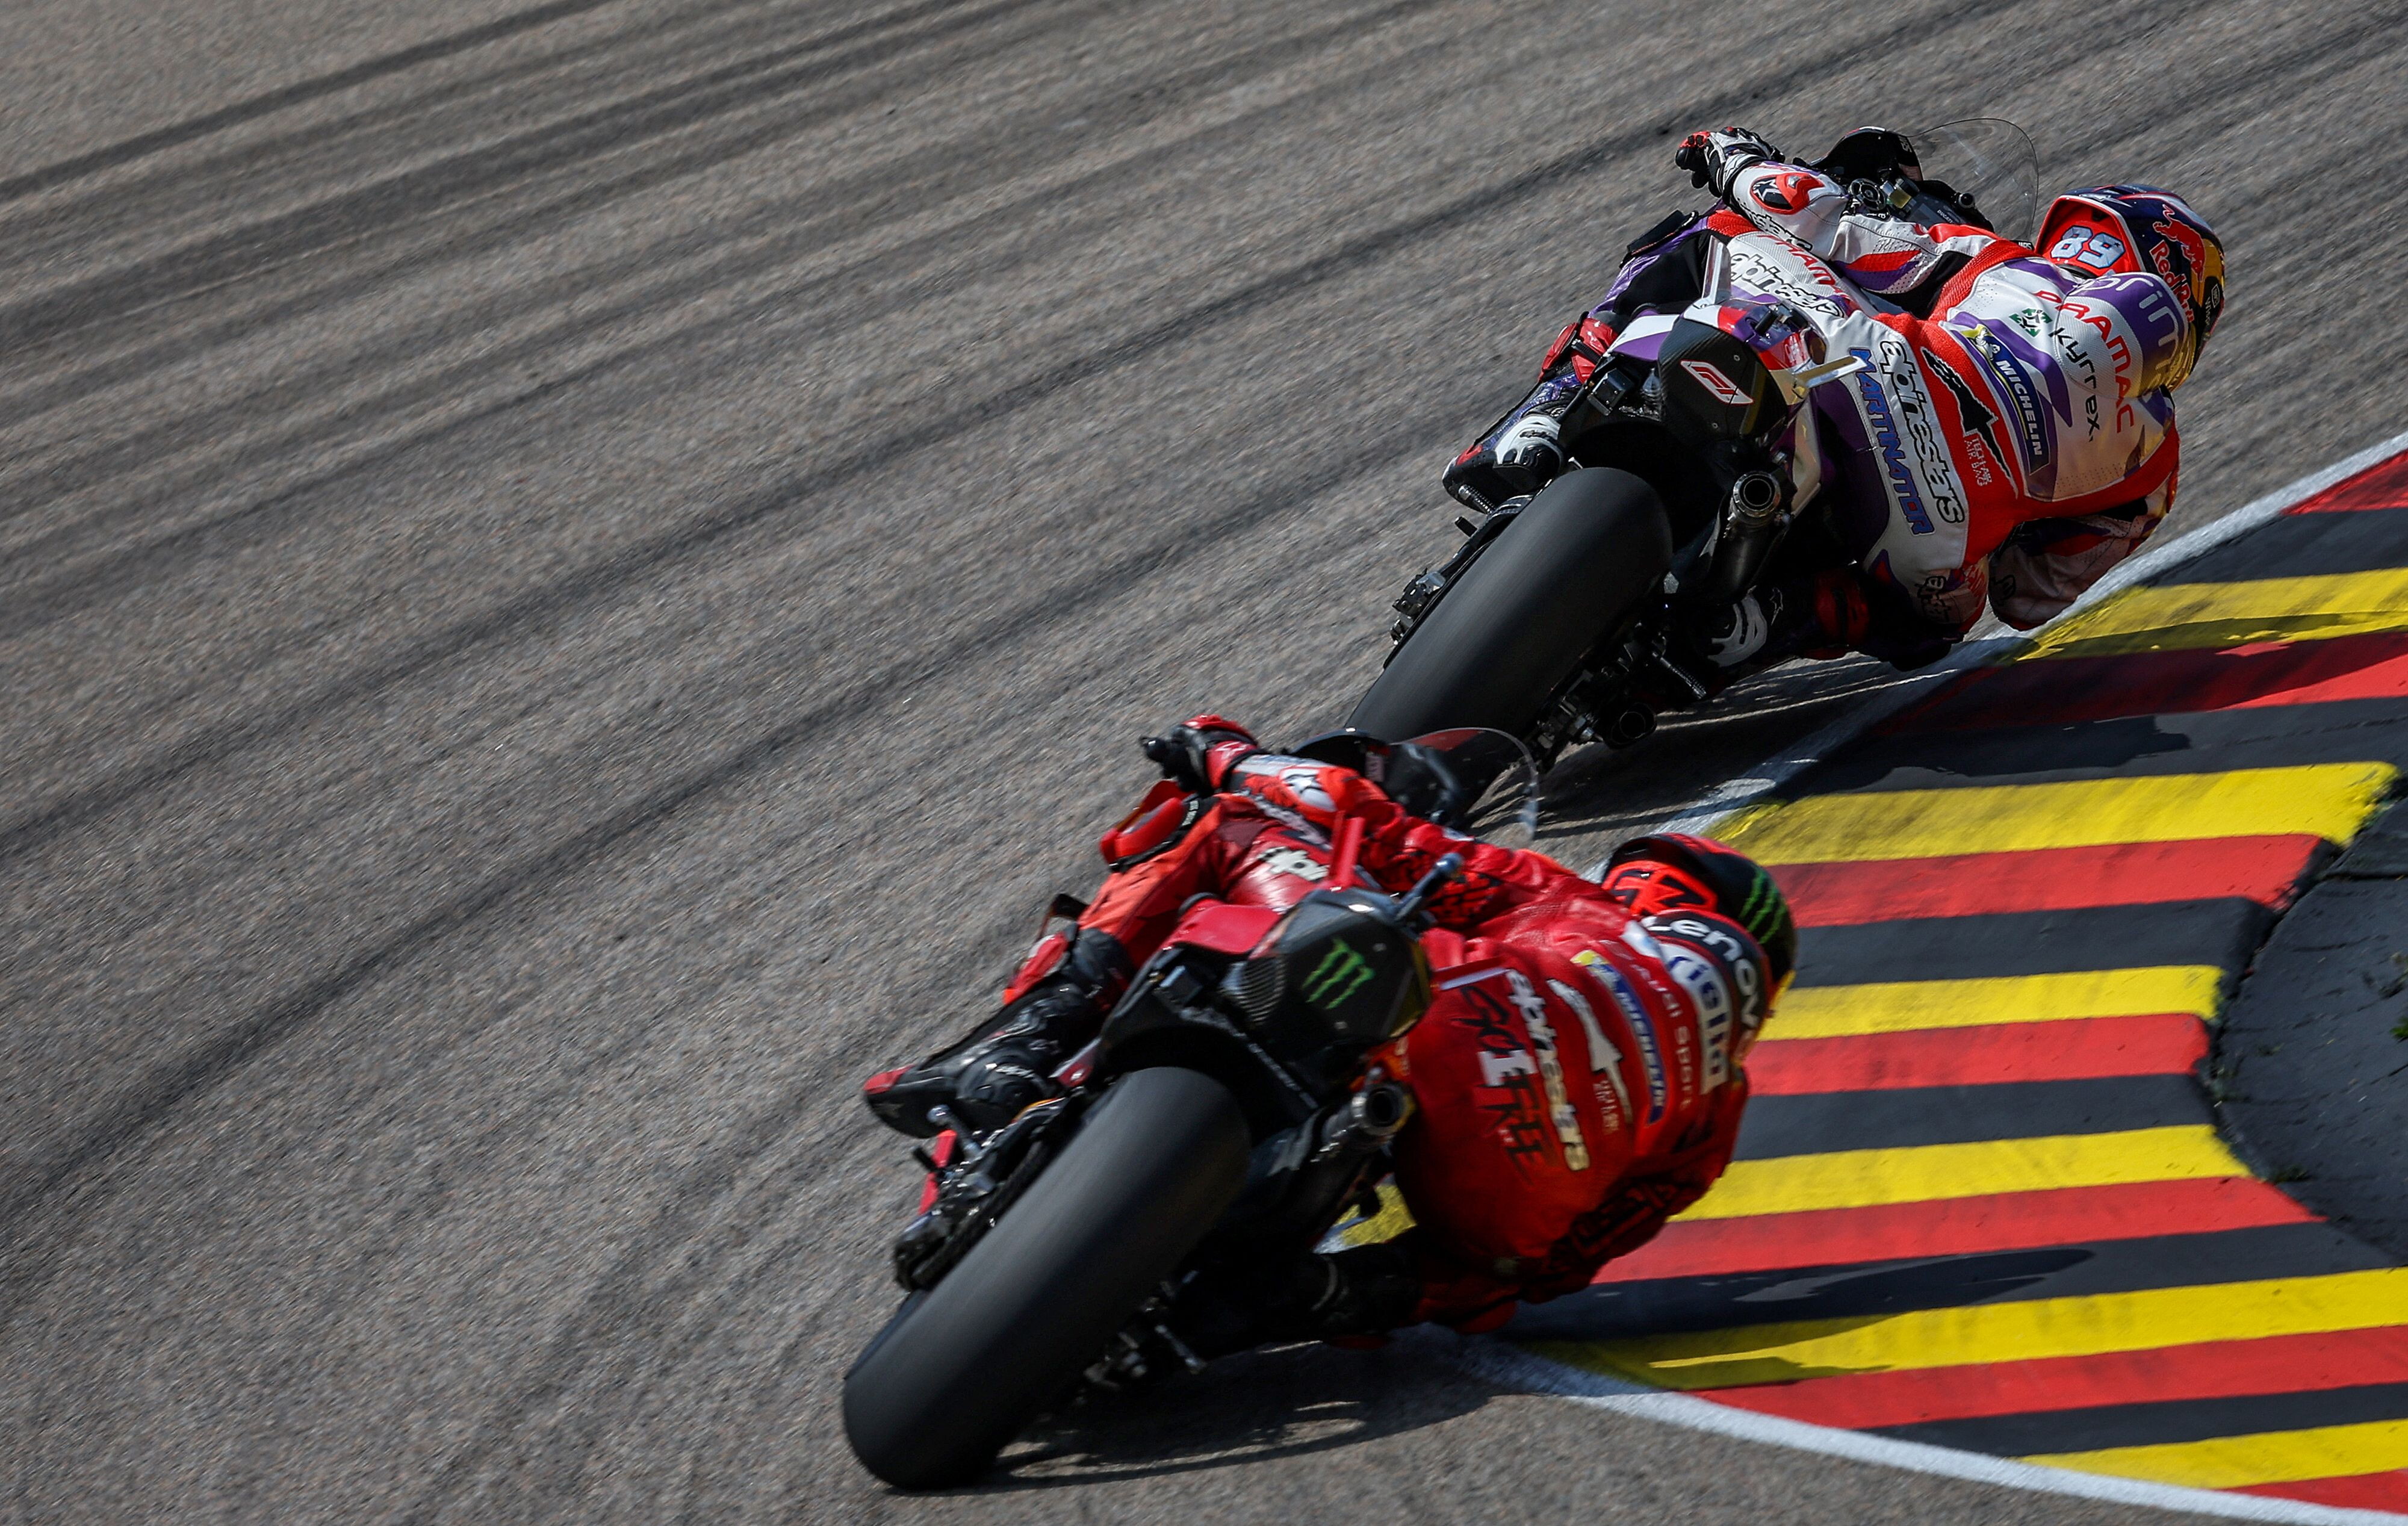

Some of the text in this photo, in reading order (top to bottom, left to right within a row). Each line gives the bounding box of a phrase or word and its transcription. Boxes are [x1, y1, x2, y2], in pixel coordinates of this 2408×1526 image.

[1937, 209, 1953, 223] DUCATI
[2050, 225, 2126, 269] 89
[2149, 240, 2187, 290] Red
[1996, 360, 2043, 456] MICHELIN
[2035, 291, 2135, 433] PRAMAC
[1849, 346, 1934, 535] MARTINATOR
[1879, 340, 1965, 524] alpinestars
[1964, 440, 1988, 486] AIR BAG
[1506, 969, 1590, 1171] alpinestars
[1615, 992, 1665, 1107] MICHELIN
